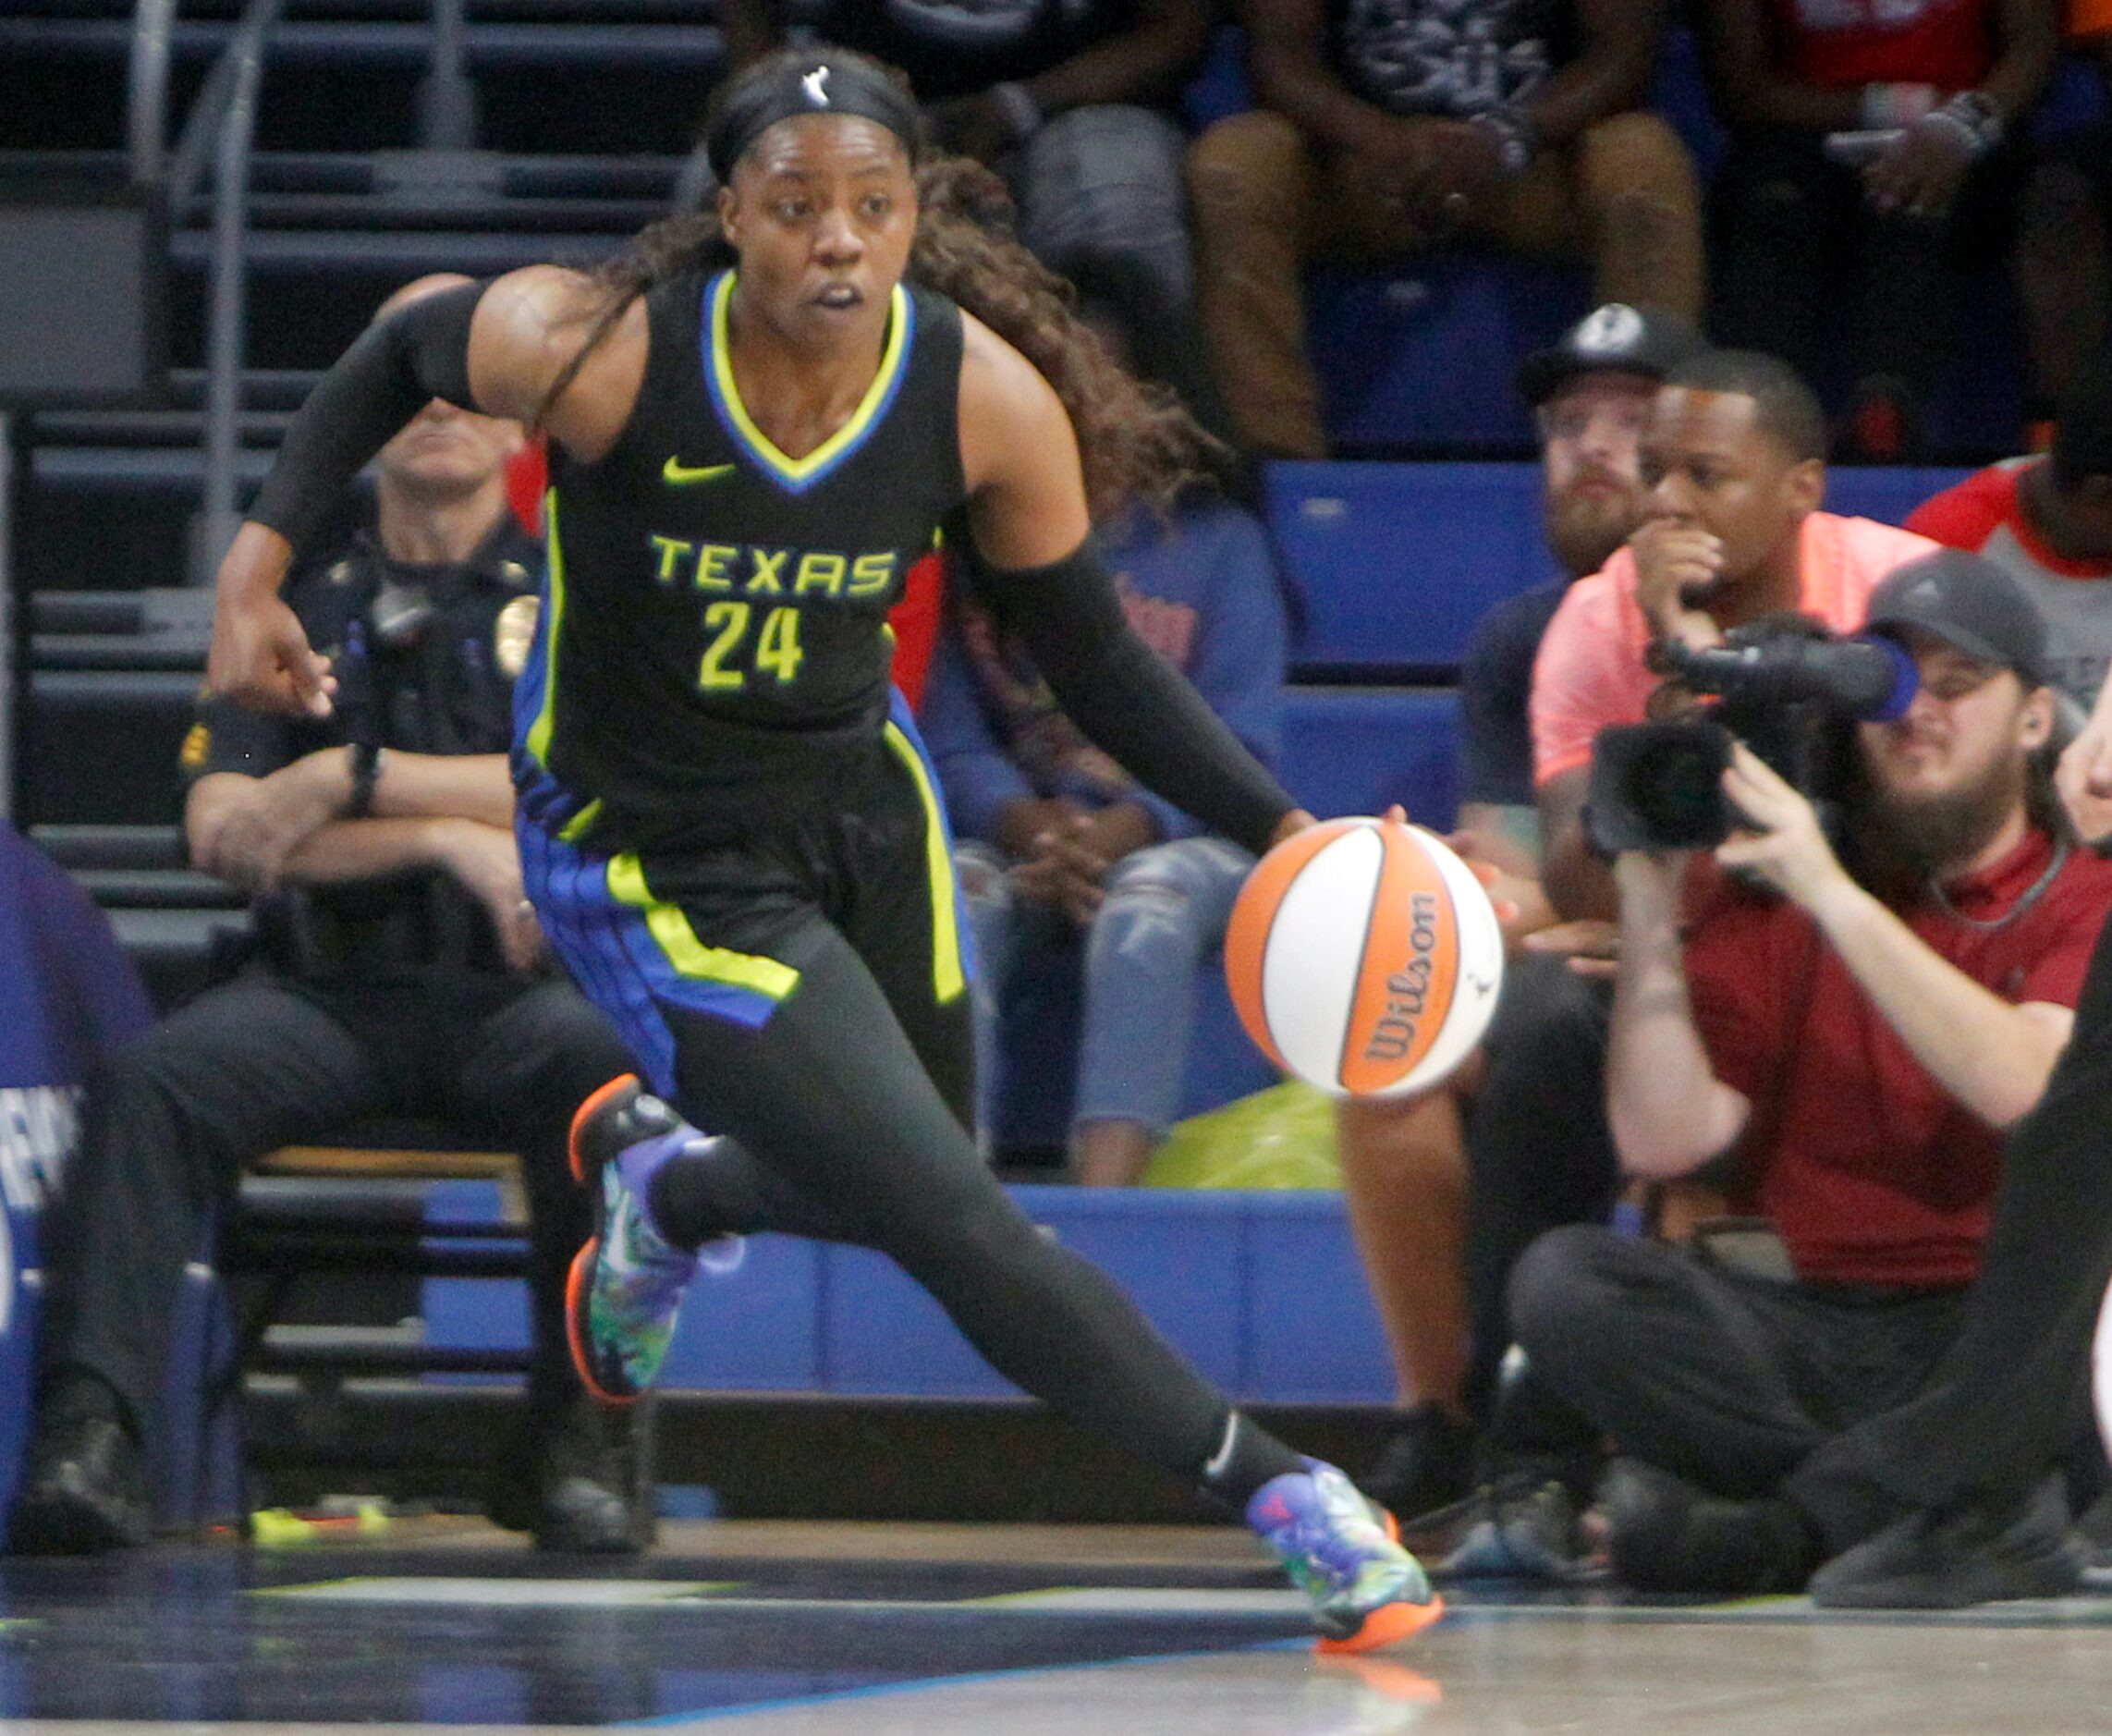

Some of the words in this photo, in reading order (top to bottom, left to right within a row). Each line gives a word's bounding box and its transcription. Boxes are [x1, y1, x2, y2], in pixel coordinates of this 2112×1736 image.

[652, 534, 896, 595] TEXAS
[700, 602, 803, 688] 24
[1364, 893, 1434, 1060] Wilson
